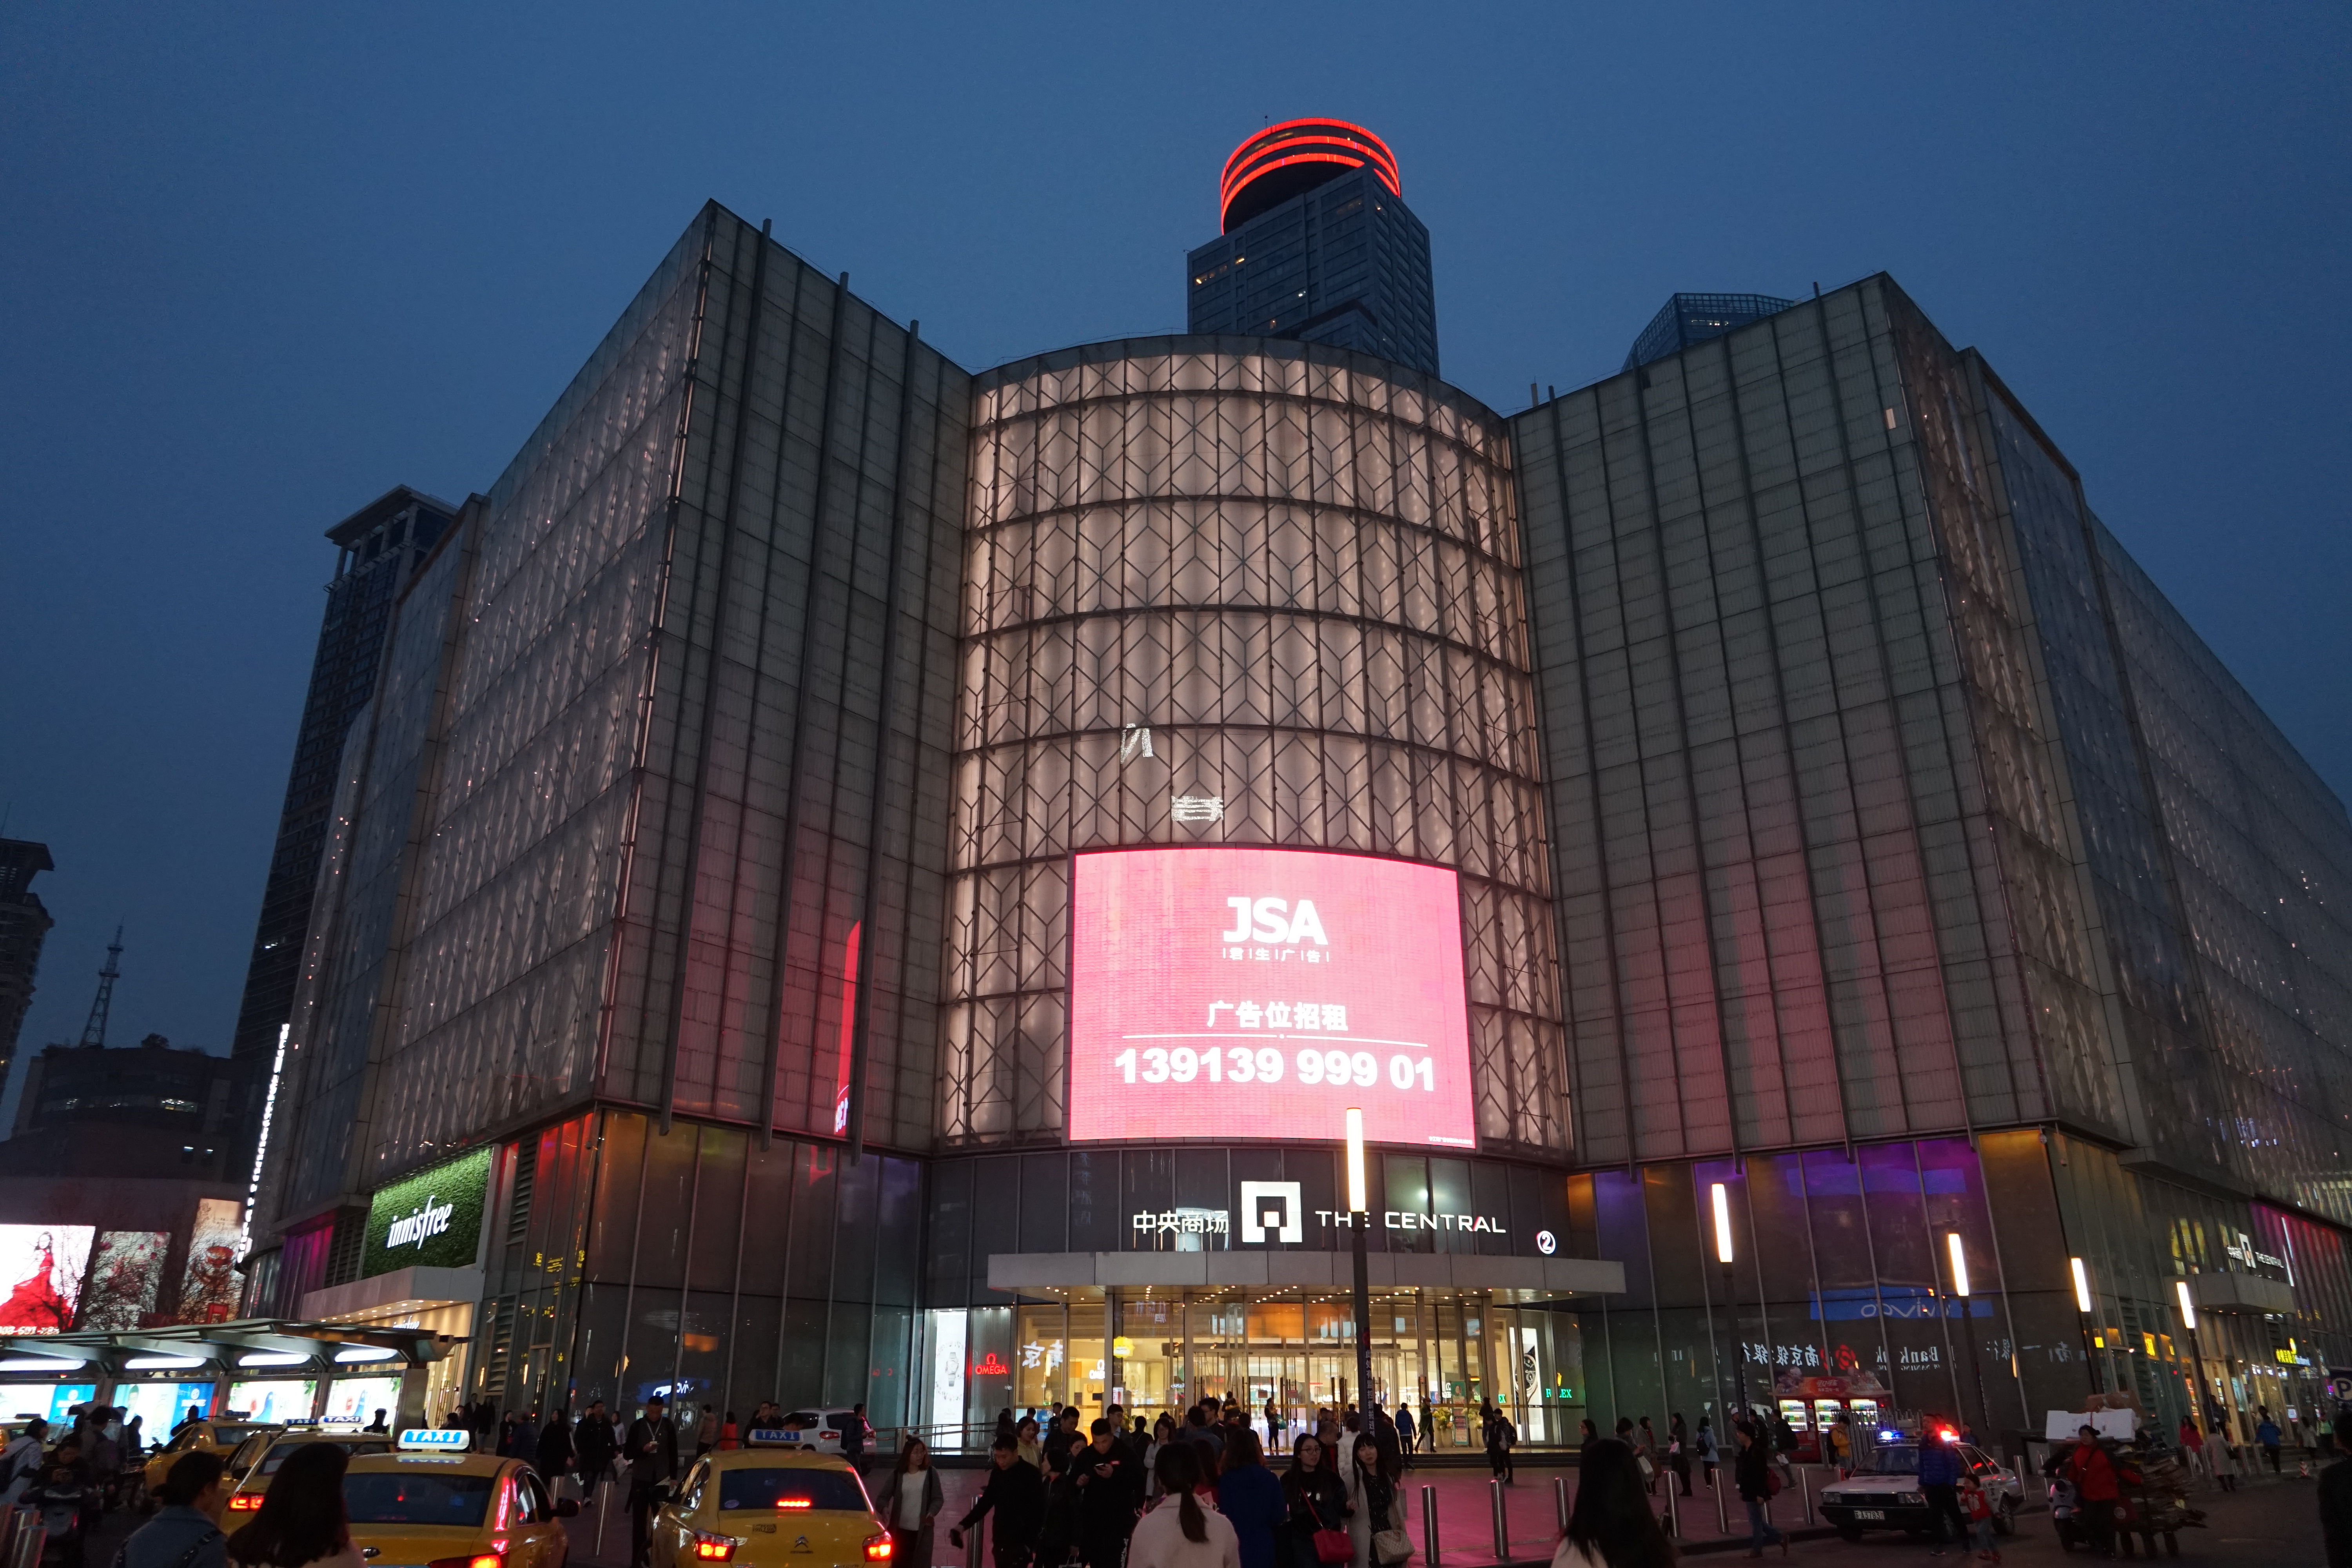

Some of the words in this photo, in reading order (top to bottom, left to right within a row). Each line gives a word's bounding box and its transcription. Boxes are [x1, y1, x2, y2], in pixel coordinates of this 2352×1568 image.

[1223, 897, 1328, 945] JSA
[1207, 1000, 1349, 1031] 广告位招租
[1115, 1047, 1284, 1083] 139139
[1296, 1049, 1378, 1087] 999
[1389, 1054, 1435, 1091] 01
[387, 1195, 453, 1250] innisfree
[1133, 1210, 1229, 1234] 中央商场
[1385, 1211, 1506, 1233] CENTRAL
[975, 1365, 1007, 1375] OMEGA
[2336, 1380, 2351, 1398] P
[412, 1431, 457, 1442] TAXI
[761, 1431, 795, 1439] TAXI
